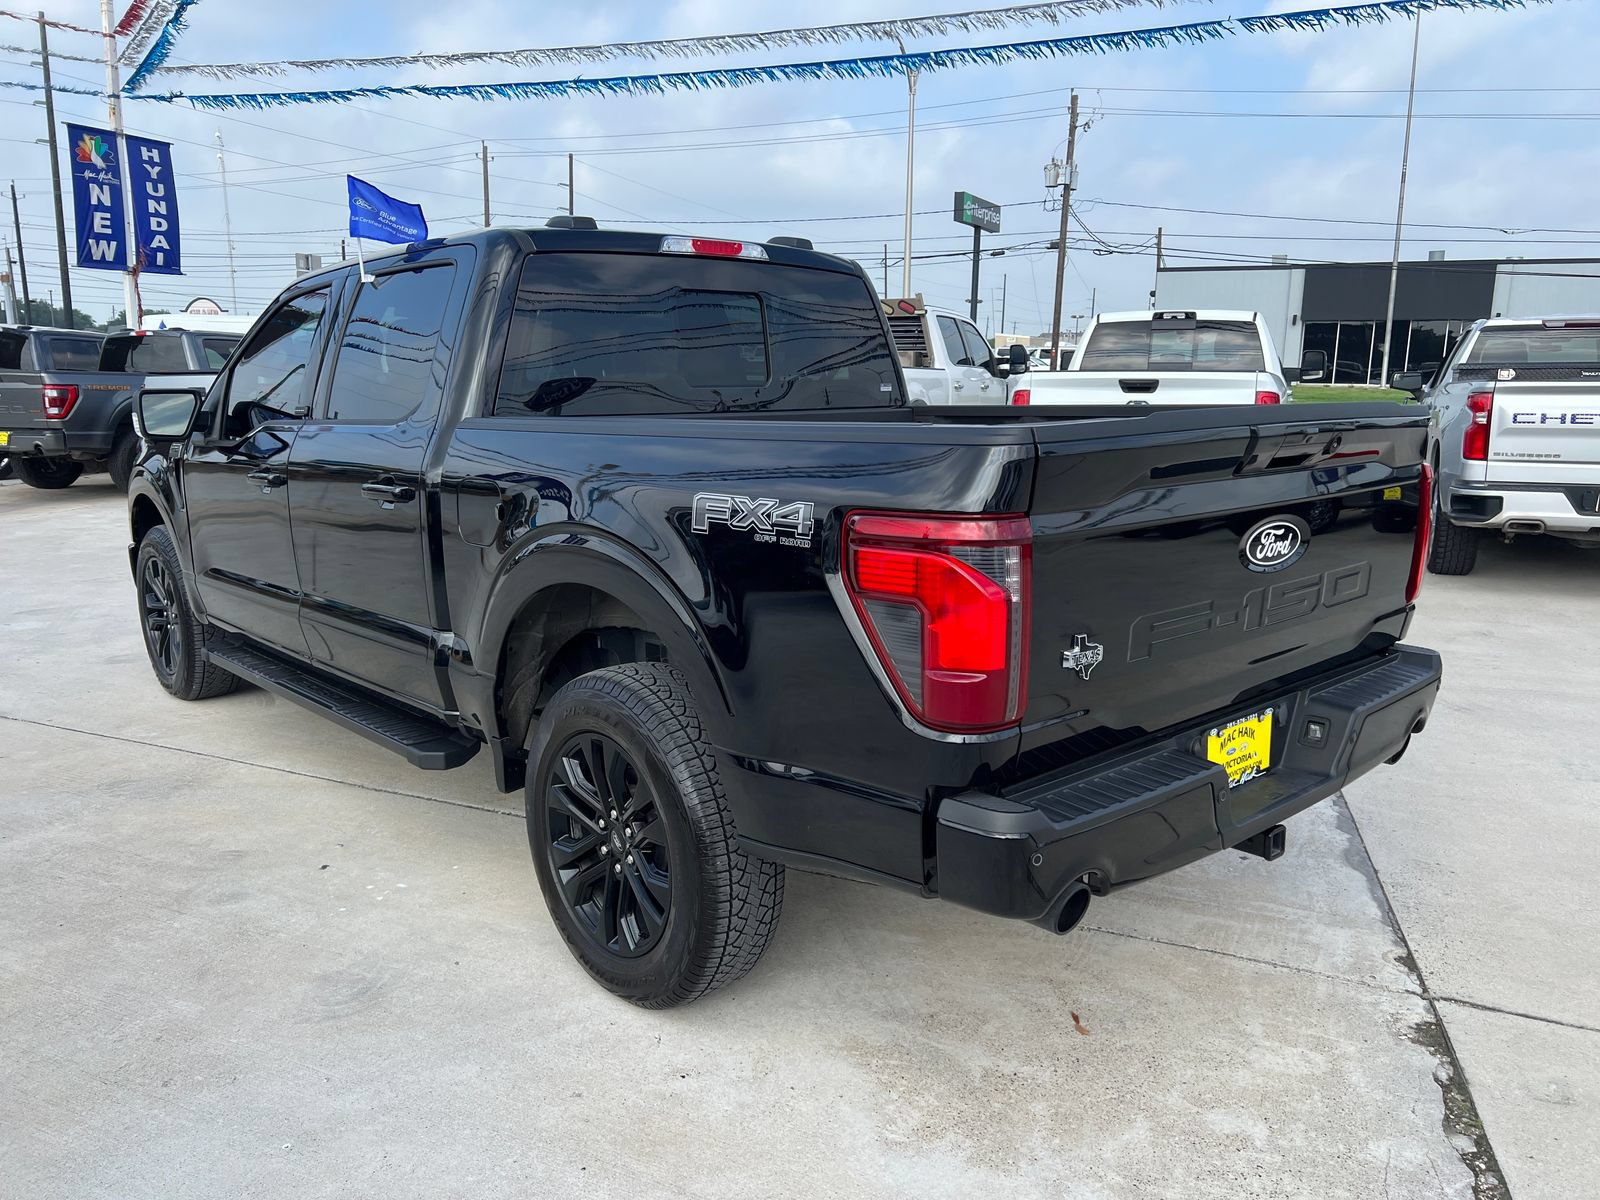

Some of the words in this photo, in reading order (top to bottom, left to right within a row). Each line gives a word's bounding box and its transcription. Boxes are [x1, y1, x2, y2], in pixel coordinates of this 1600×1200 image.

[140, 146, 170, 266] HYUNDAI
[965, 201, 1000, 225] enterprise
[88, 183, 117, 262] NEW
[359, 216, 382, 228] Certified
[378, 216, 418, 235] Advantage
[379, 211, 397, 222] Blue
[86, 384, 131, 392] TREMOR
[1512, 413, 1600, 425] CHE
[691, 492, 815, 540] FX4
[754, 533, 777, 543] OFF
[1256, 528, 1293, 559] Ford
[1127, 560, 1372, 662] F-150
[1071, 648, 1101, 665] TEXAS
[1220, 729, 1237, 754] MAC
[1237, 726, 1256, 741] HAIK
[1224, 752, 1252, 769] VICTORIA
